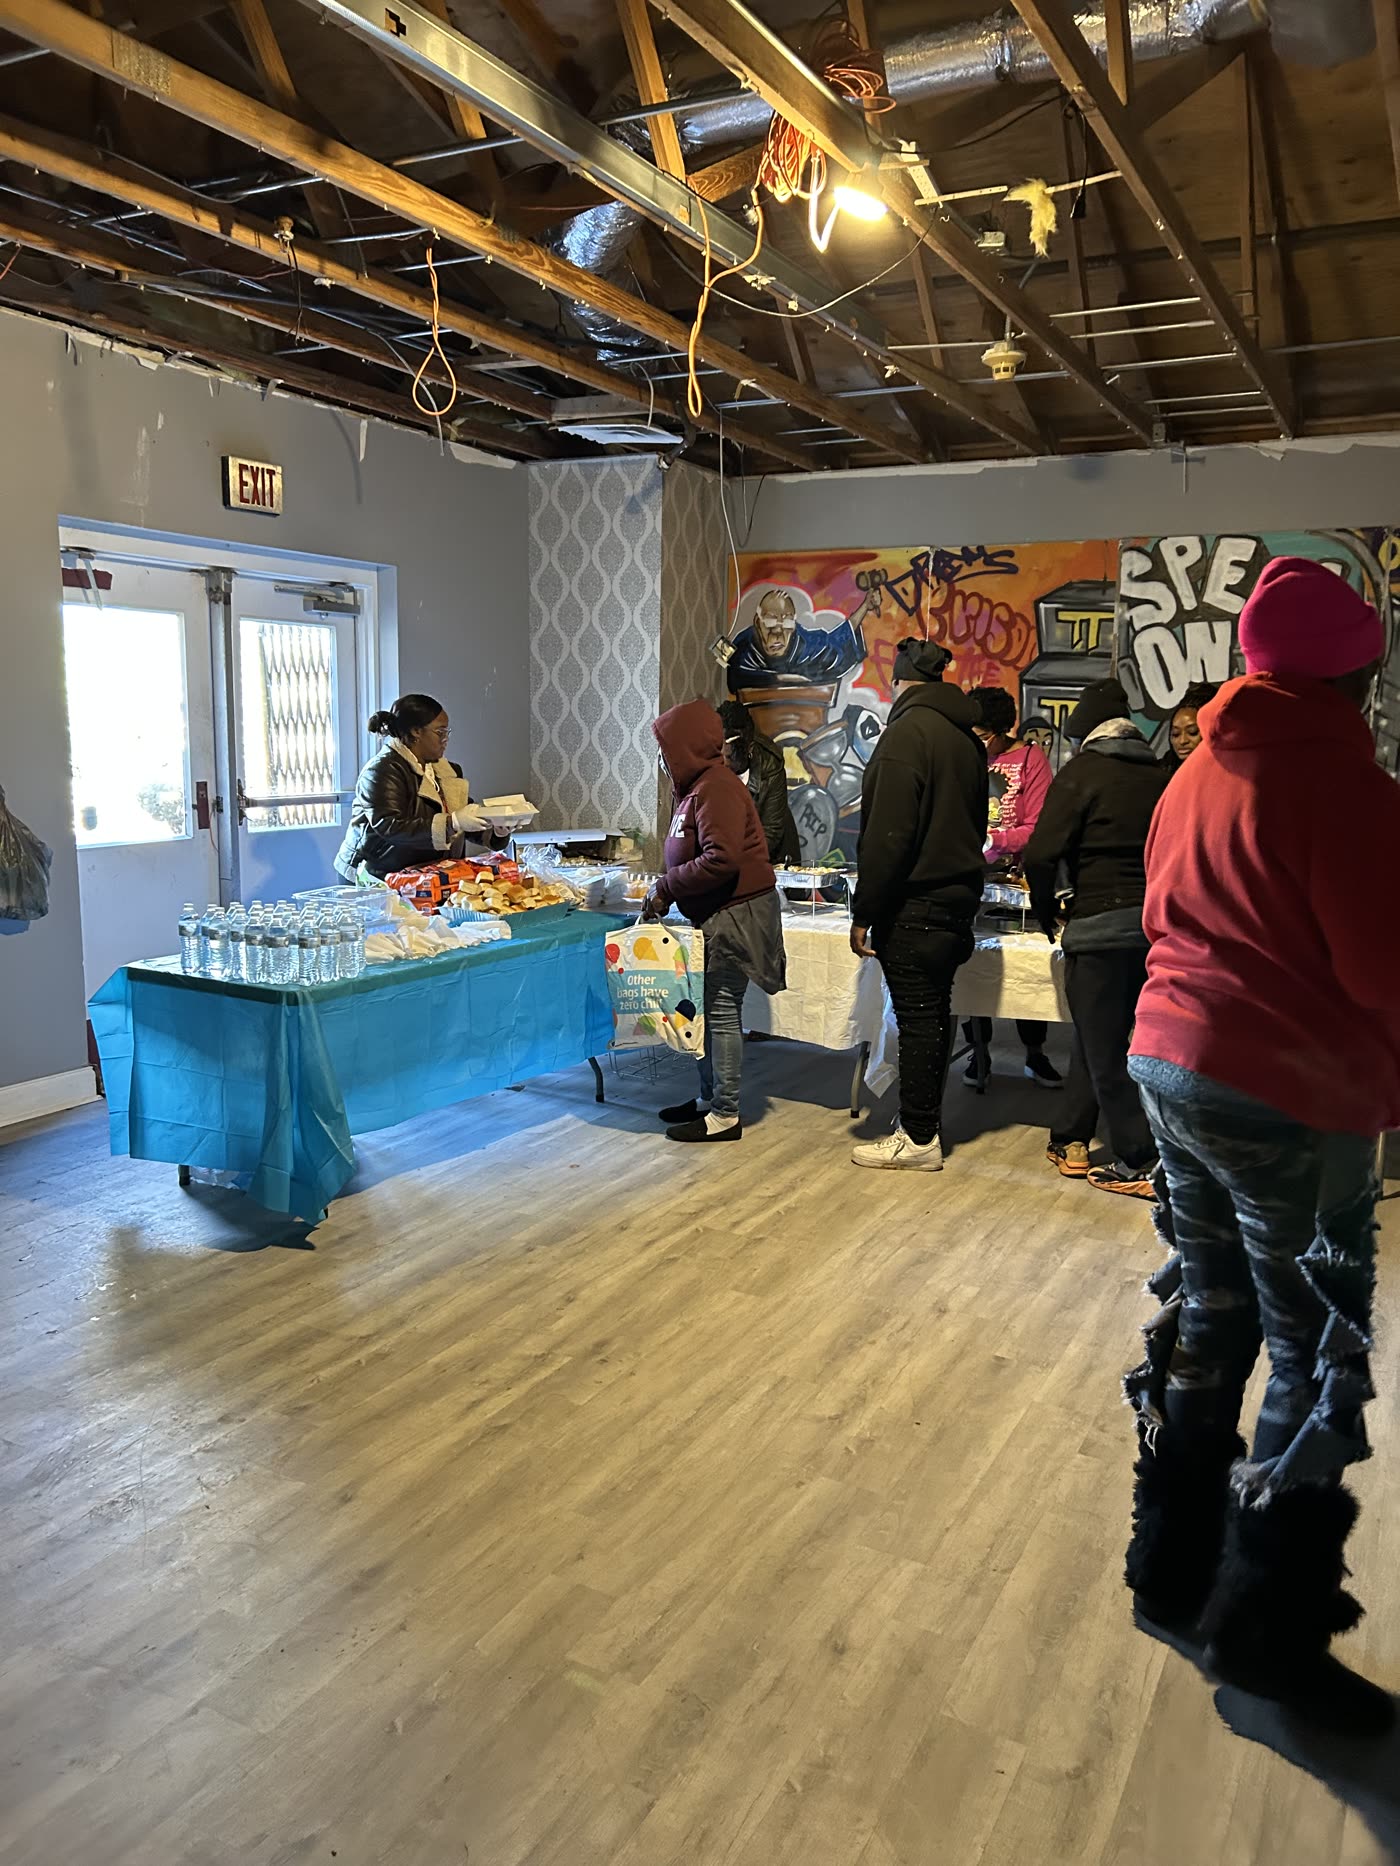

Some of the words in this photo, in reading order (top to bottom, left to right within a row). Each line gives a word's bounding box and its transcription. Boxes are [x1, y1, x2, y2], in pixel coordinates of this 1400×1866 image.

[239, 463, 276, 508] EXIT
[627, 974, 656, 985] Other
[616, 987, 639, 1000] bags
[640, 986, 669, 998] have
[620, 1001, 639, 1010] zero
